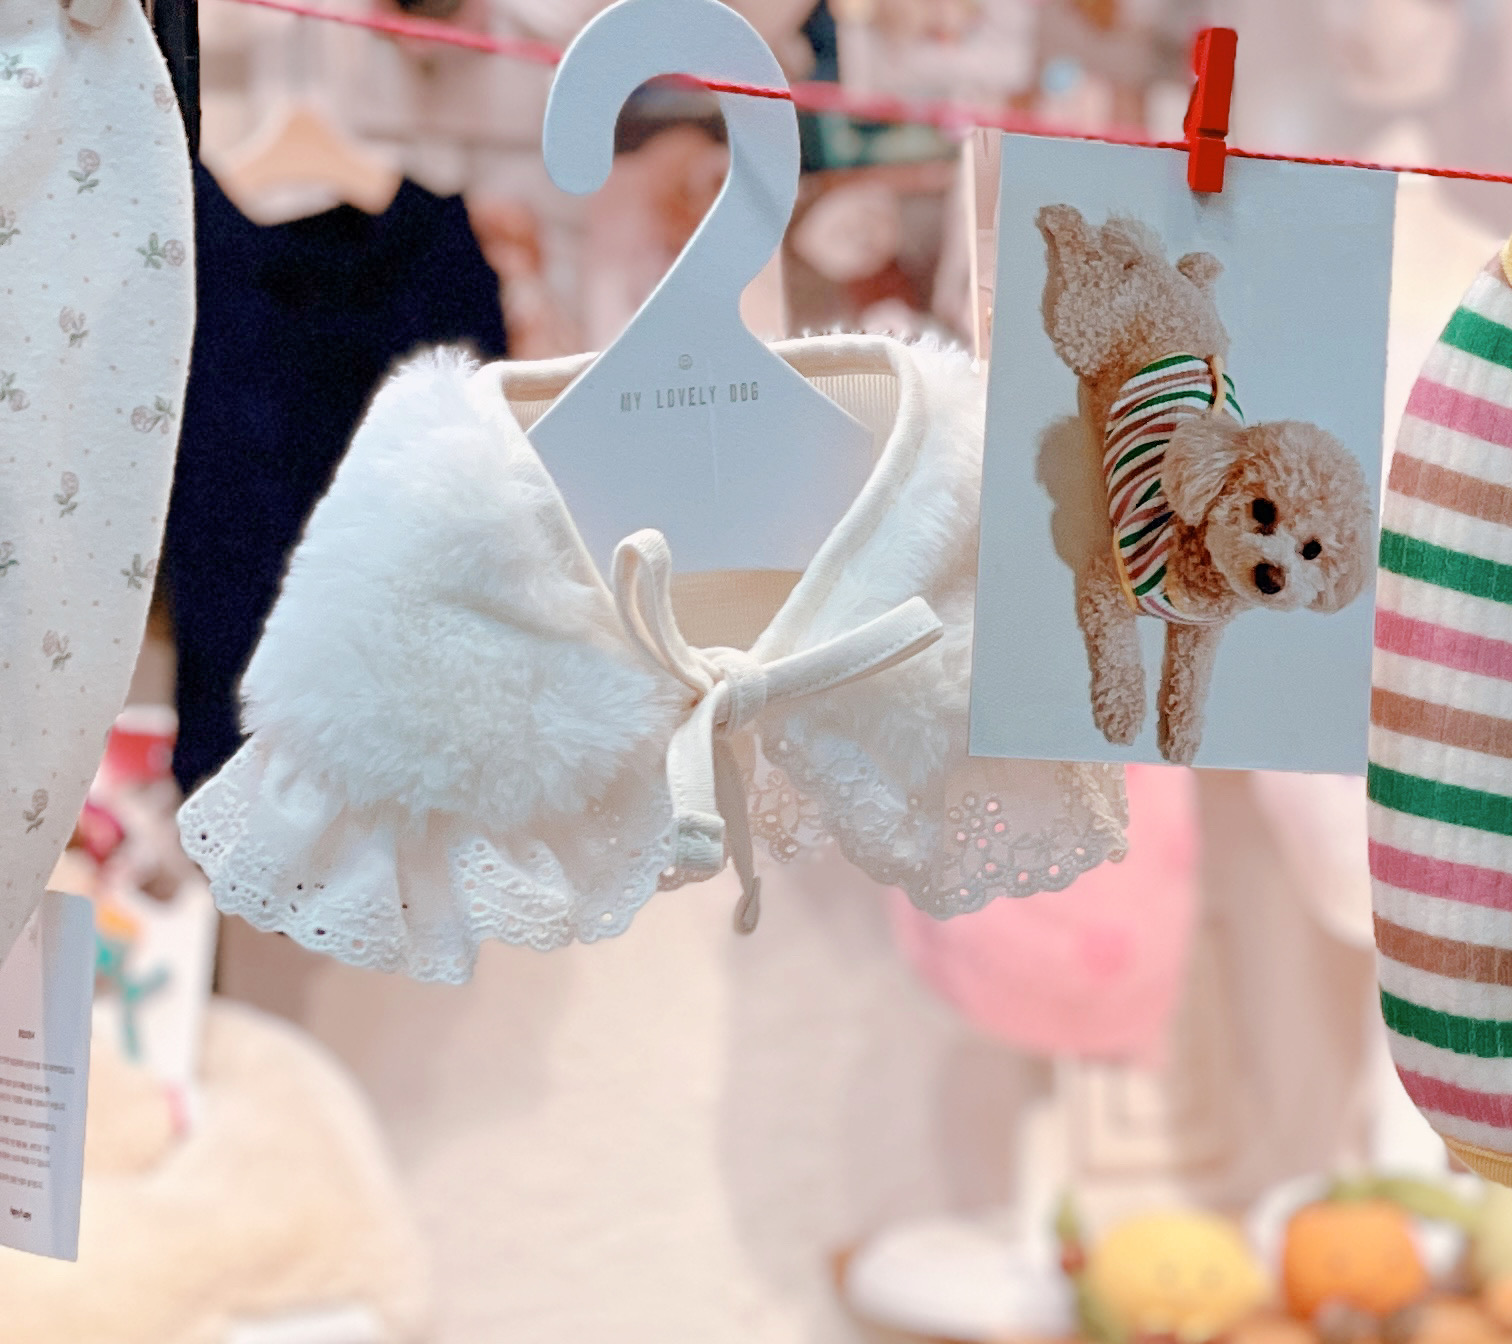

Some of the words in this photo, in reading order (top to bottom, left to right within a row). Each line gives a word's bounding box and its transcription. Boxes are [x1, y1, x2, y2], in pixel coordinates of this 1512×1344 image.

[620, 391, 642, 412] MY
[655, 385, 717, 409] LOVELY
[729, 381, 759, 403] DOG
